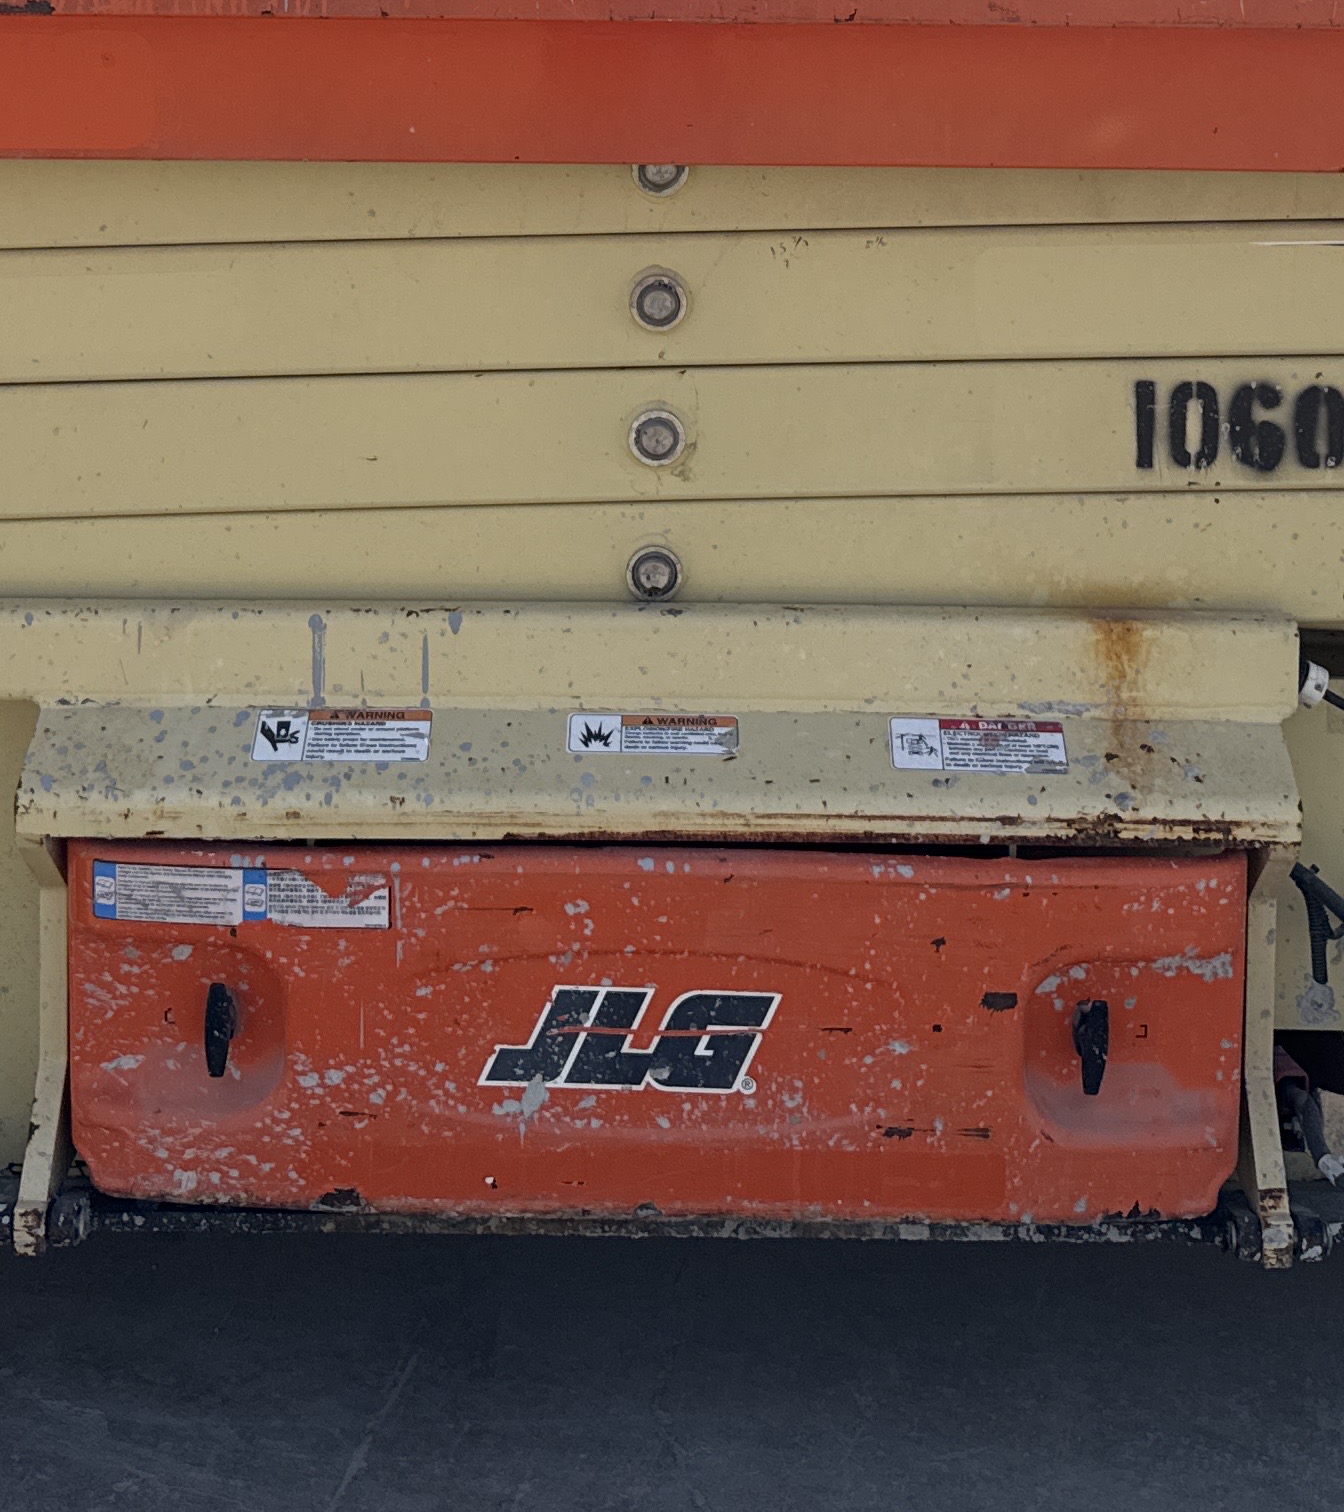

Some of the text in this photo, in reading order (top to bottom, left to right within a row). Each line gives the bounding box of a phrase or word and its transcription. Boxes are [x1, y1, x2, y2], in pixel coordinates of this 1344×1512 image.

[345, 710, 406, 720] WARNING
[656, 717, 718, 725] WARNING
[477, 984, 783, 1092] JLG
